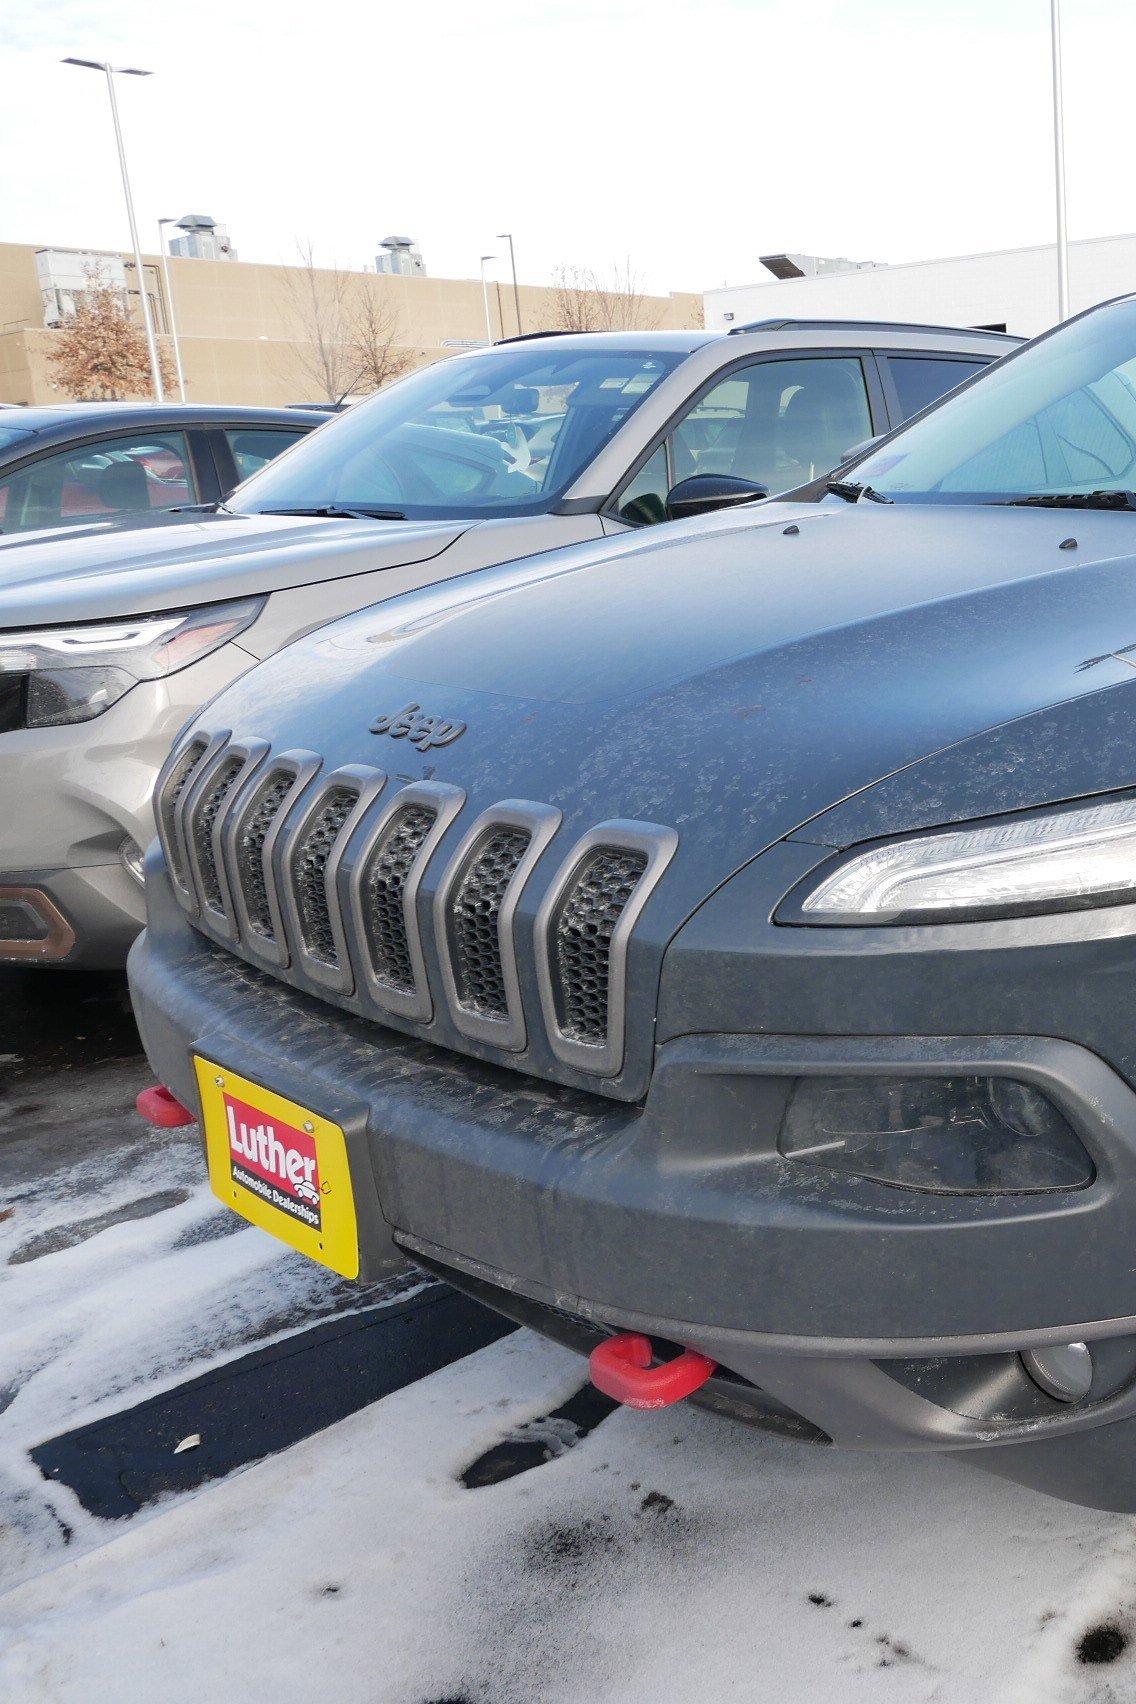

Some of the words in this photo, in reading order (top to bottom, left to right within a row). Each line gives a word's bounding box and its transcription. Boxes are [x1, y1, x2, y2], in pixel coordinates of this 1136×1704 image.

[368, 702, 467, 752] Jeep
[226, 1105, 316, 1183] Luther
[232, 1166, 272, 1199] Automobile
[272, 1189, 319, 1225] Dealerships
